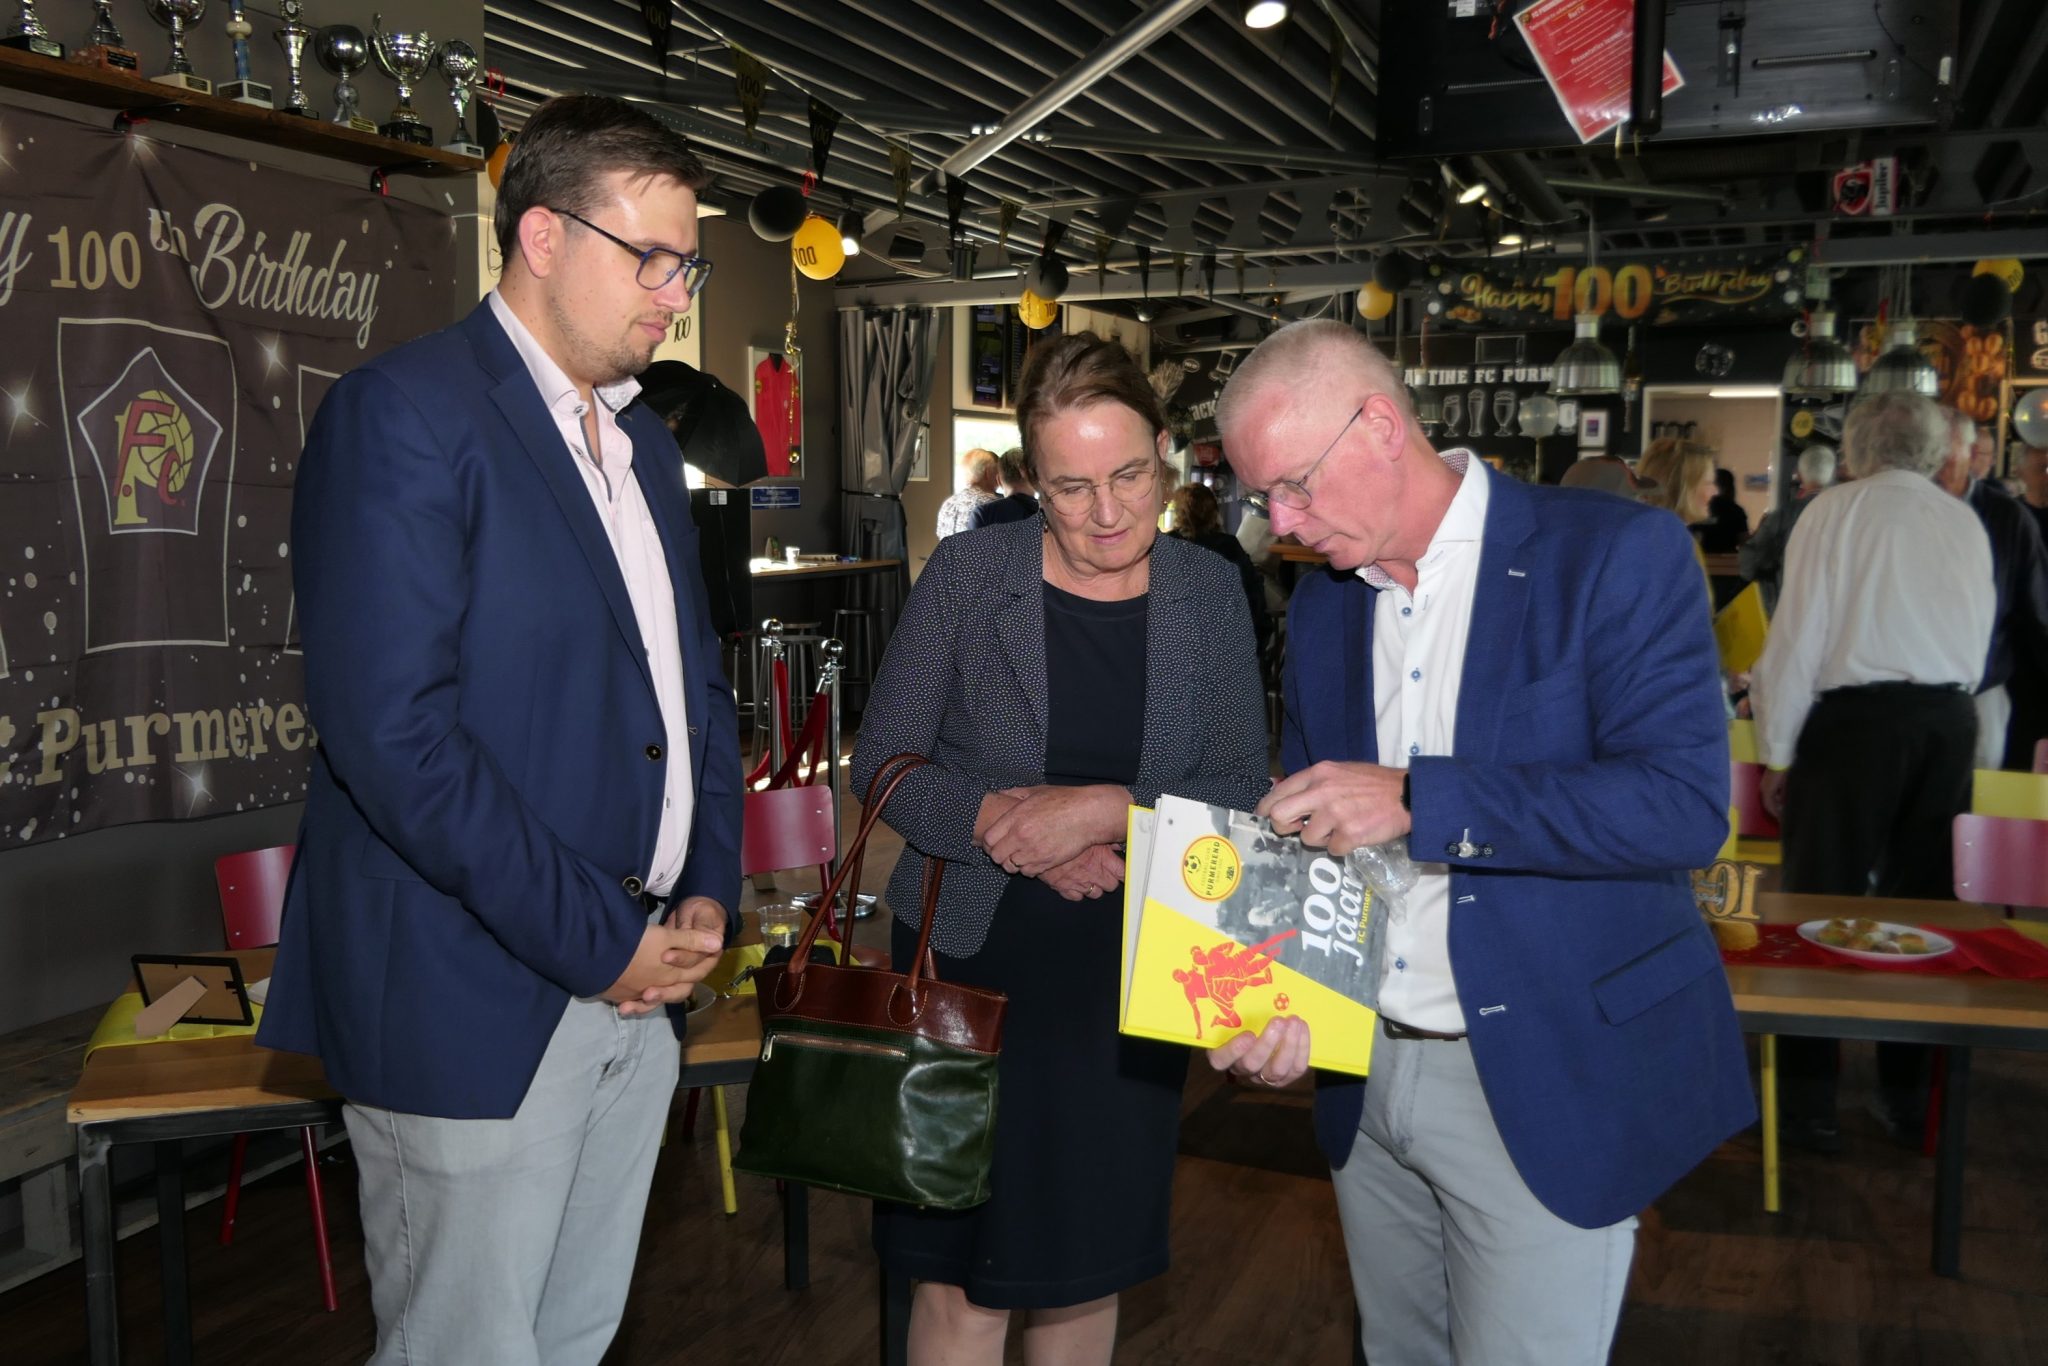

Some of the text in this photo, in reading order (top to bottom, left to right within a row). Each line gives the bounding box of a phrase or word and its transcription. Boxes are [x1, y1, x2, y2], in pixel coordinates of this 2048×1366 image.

[190, 203, 380, 350] Birthday
[795, 246, 817, 266] 100
[1461, 264, 1771, 321] Happy 100 Birthday
[674, 315, 691, 343] 100
[1404, 366, 1554, 386] ATINE FC PURM
[1190, 400, 1217, 421] ack
[35, 703, 319, 787] Purmere
[1206, 841, 1220, 896] PURMEREND
[1301, 857, 1341, 957] 100
[1357, 930, 1366, 944] FC
